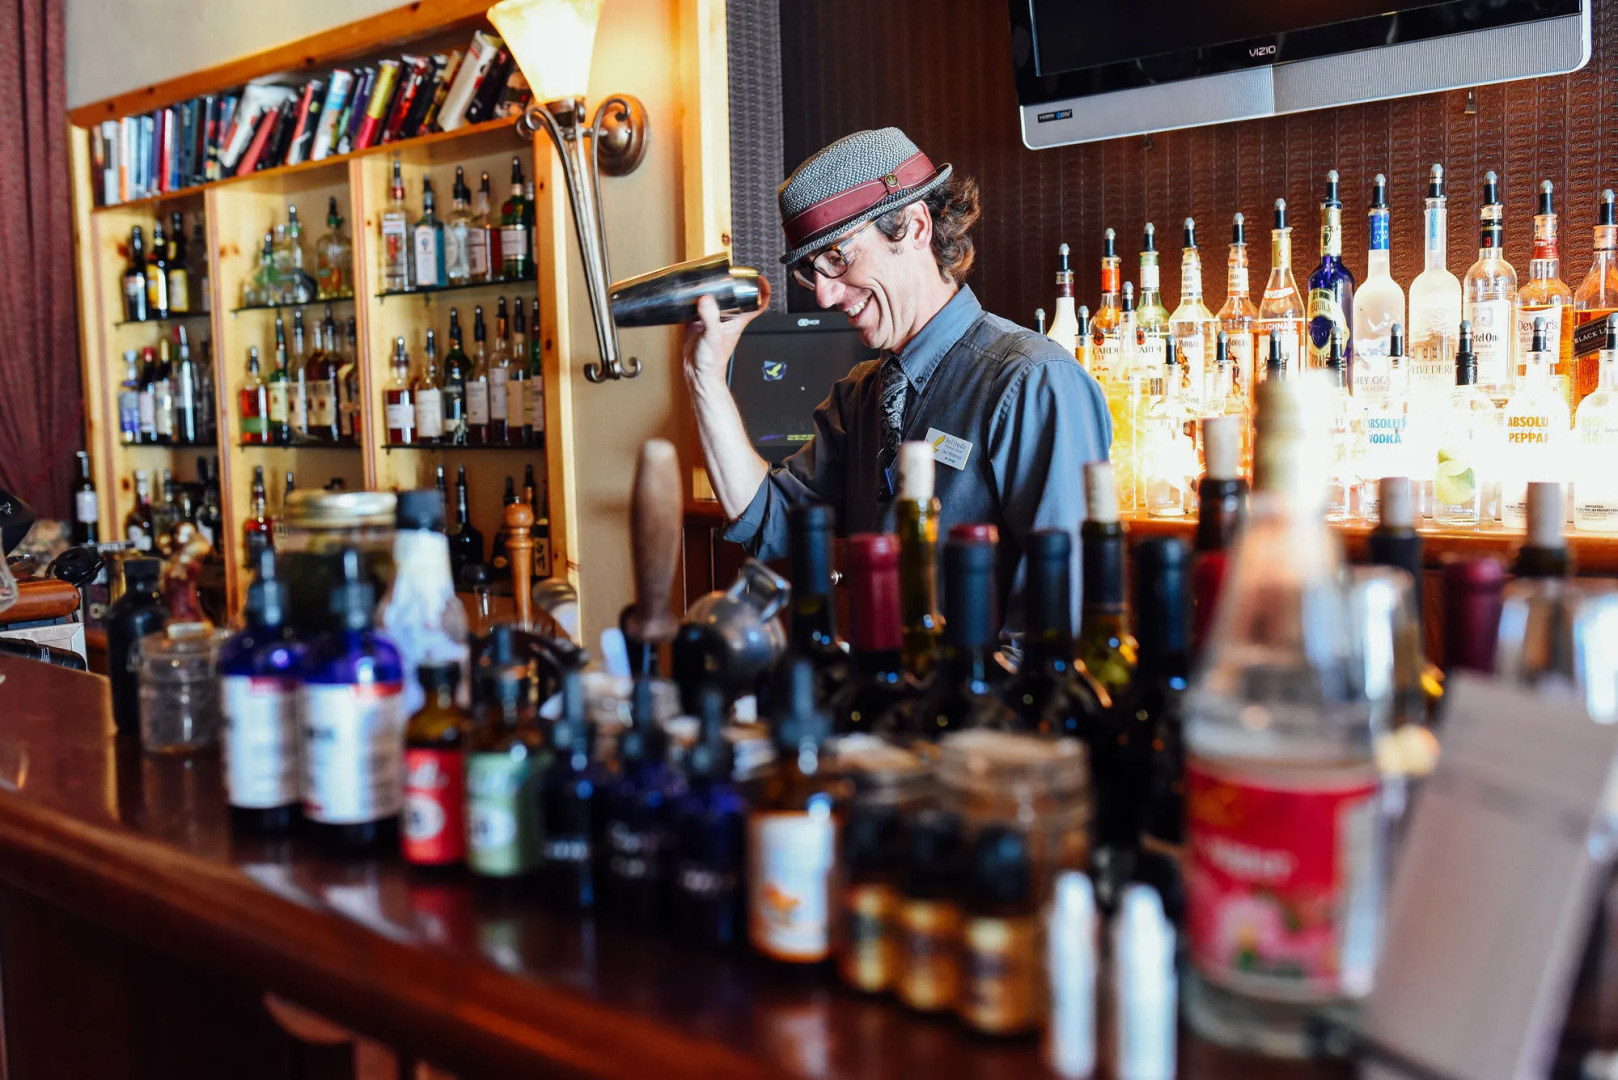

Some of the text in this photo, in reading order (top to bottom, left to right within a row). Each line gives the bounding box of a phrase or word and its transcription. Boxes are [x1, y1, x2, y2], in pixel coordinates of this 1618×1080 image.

[1248, 45, 1277, 58] VIZIO
[1472, 332, 1485, 342] etel
[1574, 331, 1599, 345] BLACK
[1507, 416, 1549, 428] ABSOLU
[1368, 433, 1402, 444] VODKA
